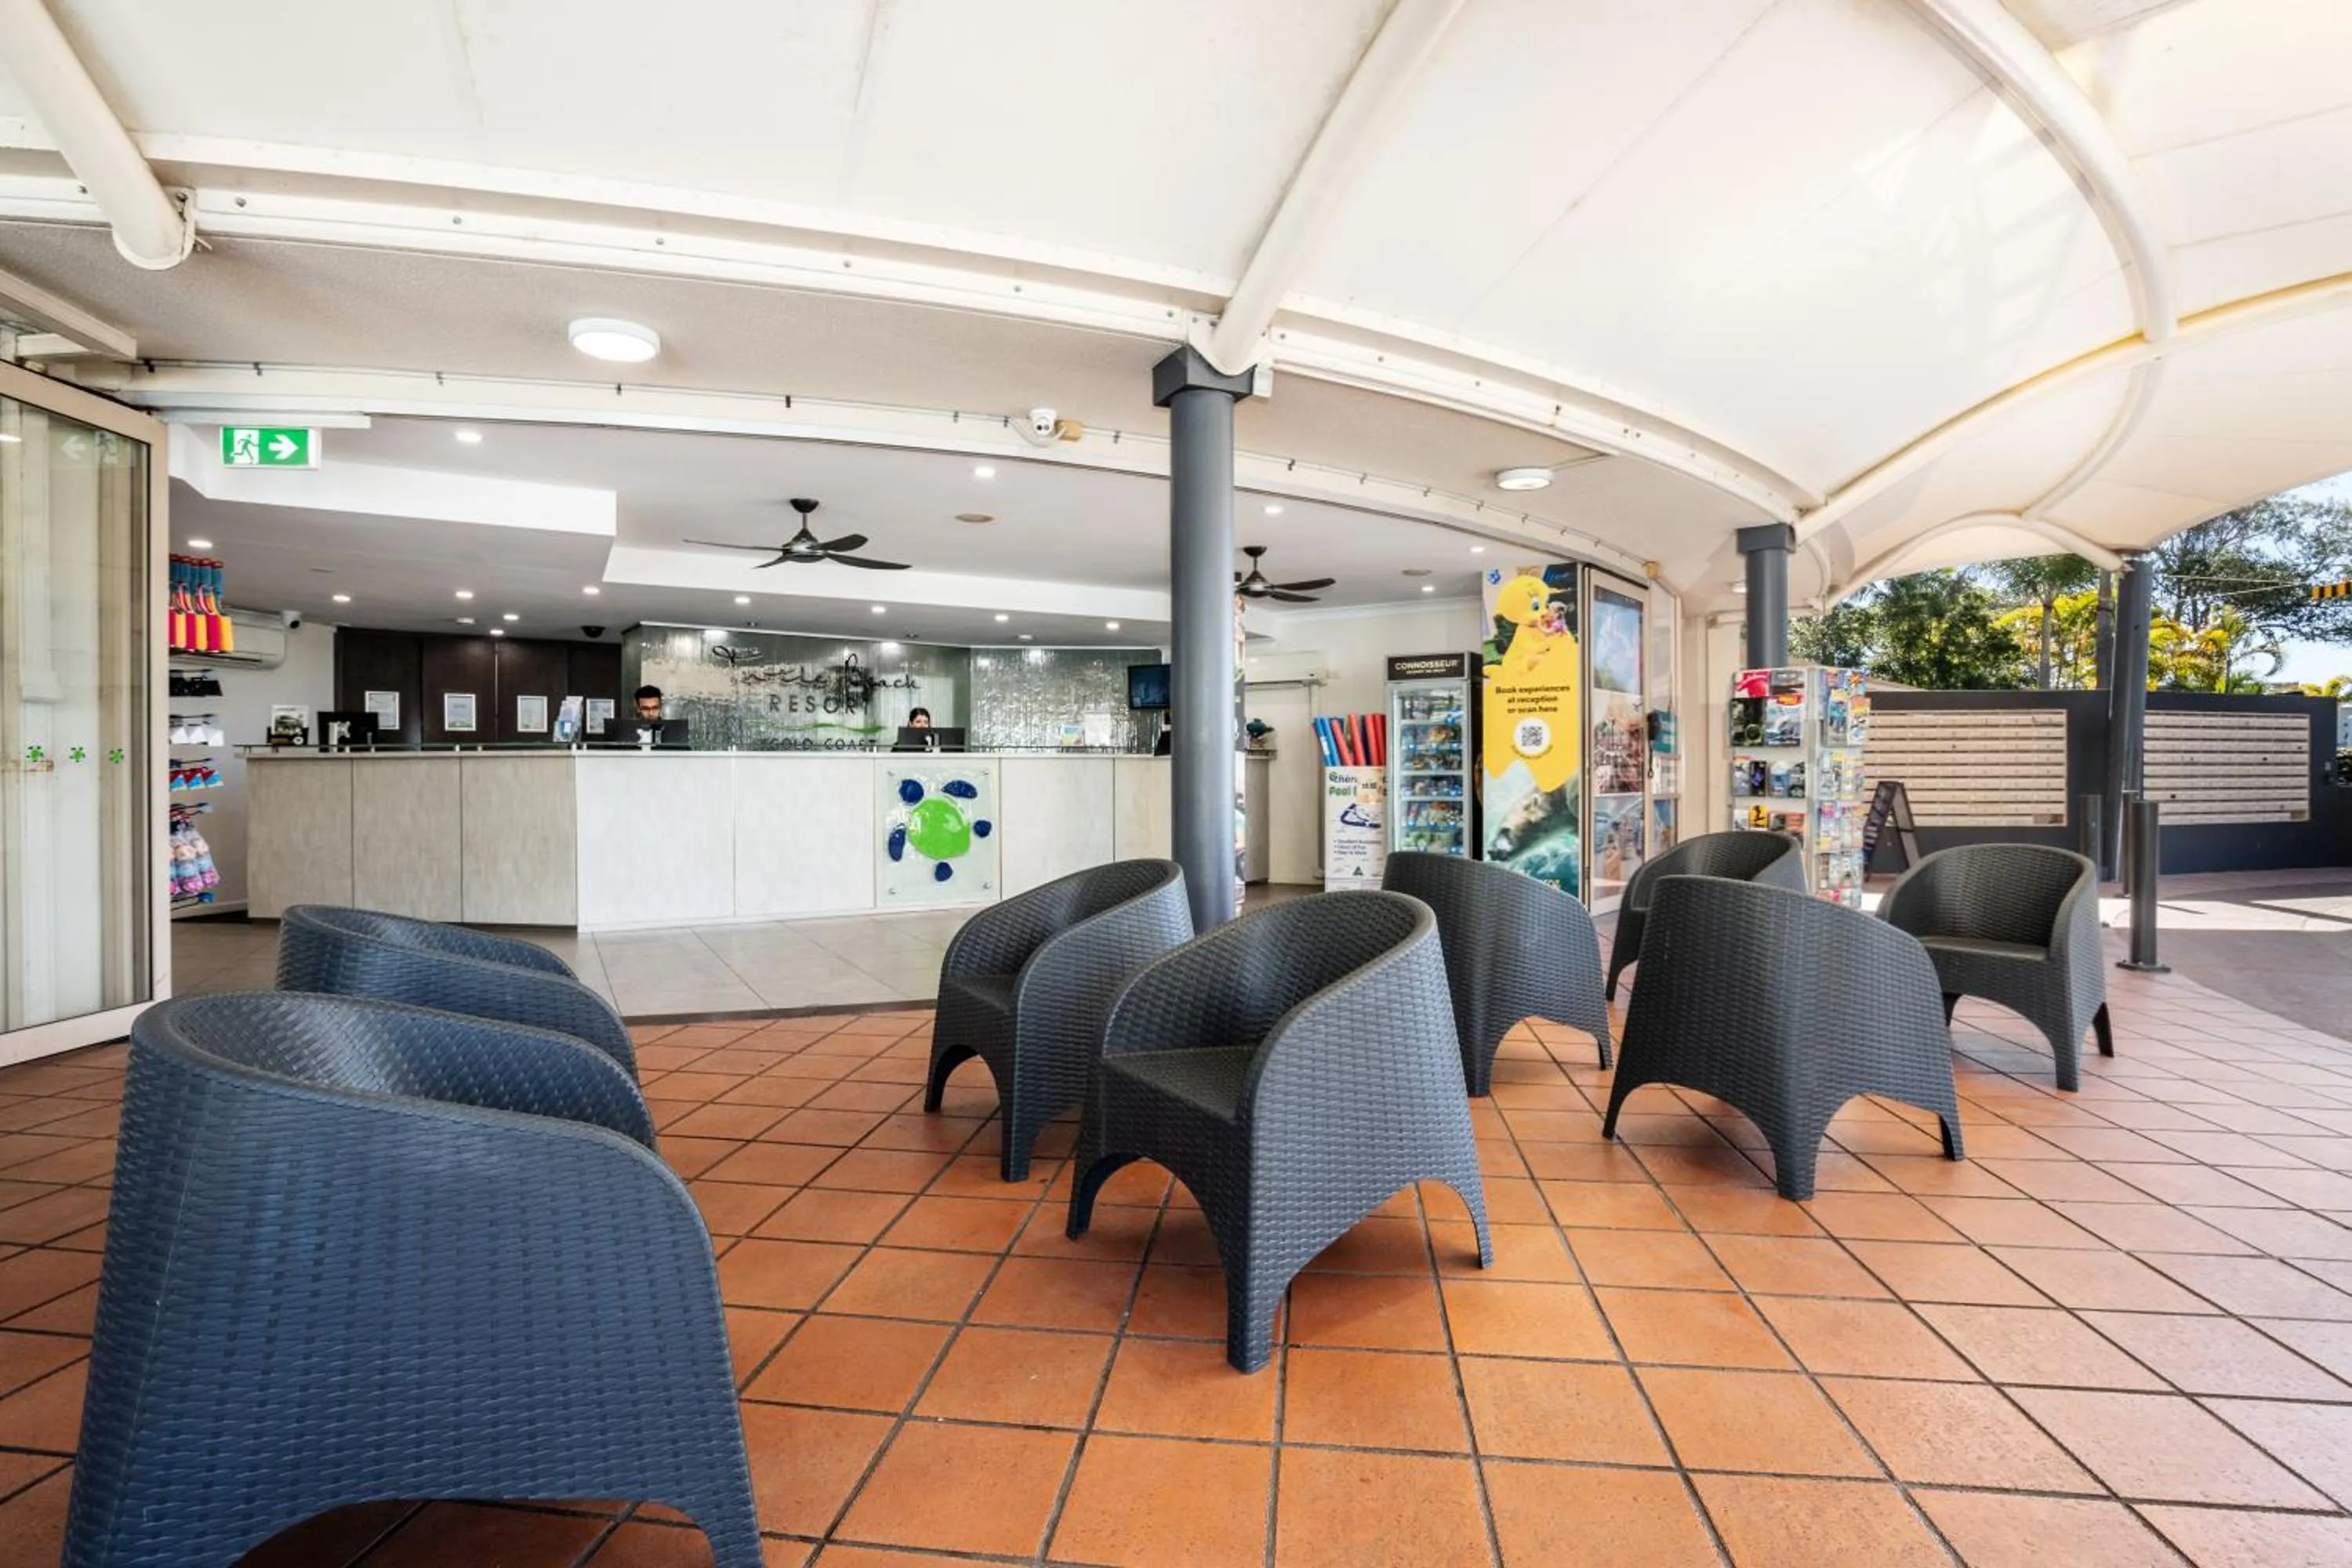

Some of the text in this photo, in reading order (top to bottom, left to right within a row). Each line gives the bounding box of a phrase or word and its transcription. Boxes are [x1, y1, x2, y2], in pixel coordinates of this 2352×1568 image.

[1395, 659, 1458, 670] CONNOISSEUR
[1519, 685, 1570, 695] experiences
[768, 693, 870, 714] RESORT
[1517, 695, 1558, 705] reception
[771, 737, 877, 750] GOLD COAST
